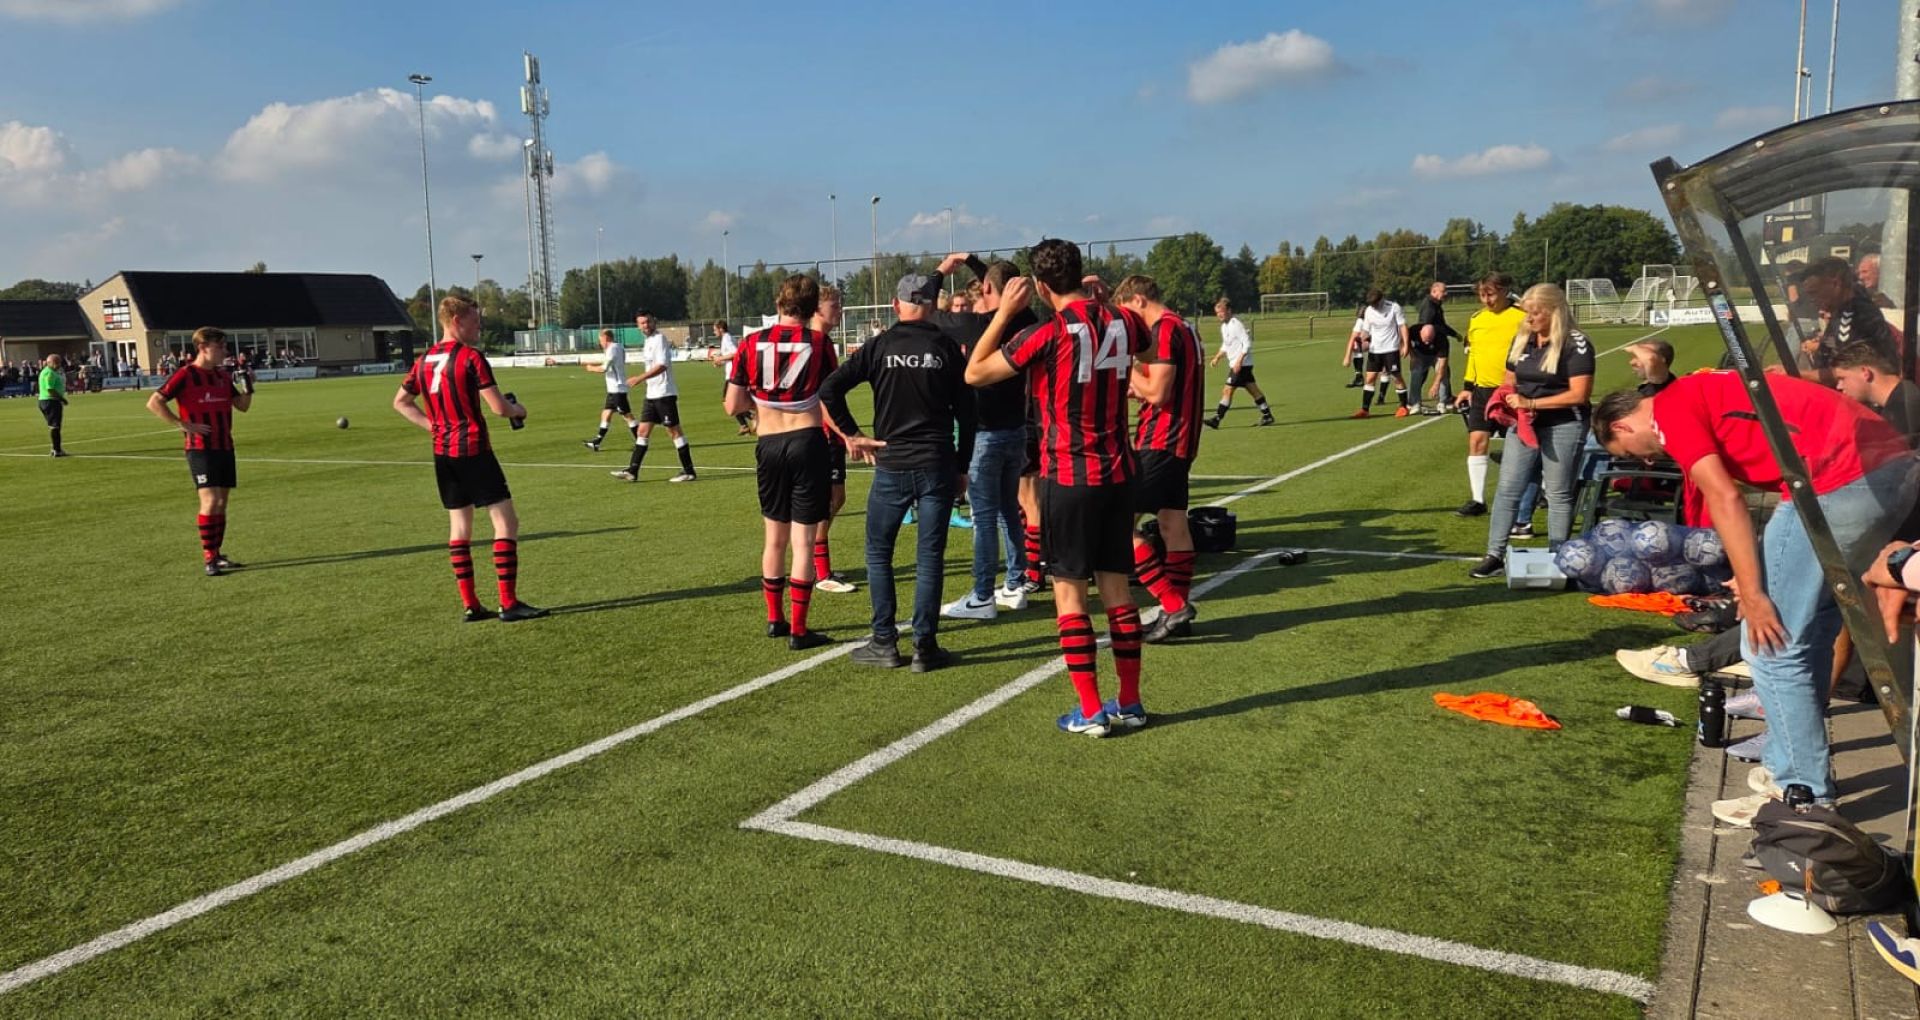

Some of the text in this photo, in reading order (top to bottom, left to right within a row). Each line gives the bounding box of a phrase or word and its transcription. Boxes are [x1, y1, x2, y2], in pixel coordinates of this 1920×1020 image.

[755, 341, 812, 390] 17
[886, 354, 919, 369] ING
[1066, 318, 1131, 384] 14
[425, 353, 450, 394] 7
[196, 474, 208, 485] 15
